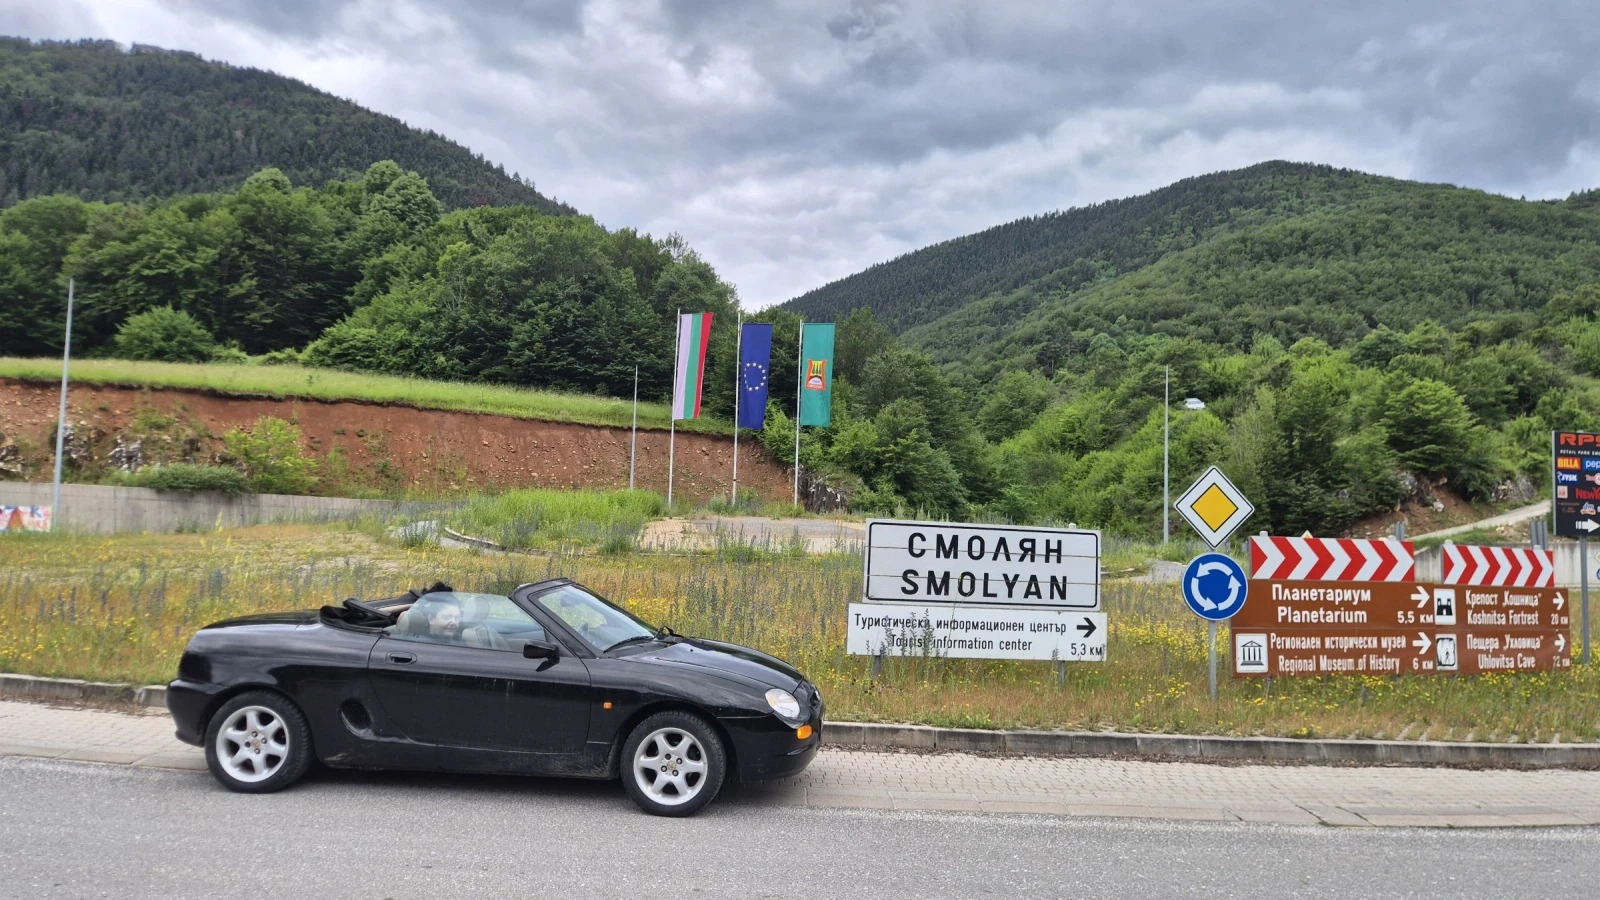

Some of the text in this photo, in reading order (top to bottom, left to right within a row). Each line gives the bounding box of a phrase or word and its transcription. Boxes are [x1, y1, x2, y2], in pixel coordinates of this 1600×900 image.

[1557, 458, 1579, 468] BILLA
[908, 532, 1062, 563] СМОЛЯН
[900, 569, 1067, 600] SMOLYAN
[1272, 584, 1371, 605] Планетариум
[1466, 589, 1498, 609] Крепост
[1278, 606, 1367, 623] Planetarium
[1467, 609, 1539, 625] Koshnitsa Fortrest
[1551, 613, 1559, 625] 20
[936, 619, 1024, 632] информационен
[1030, 622, 1066, 636] център
[934, 636, 993, 650] information
[999, 638, 1032, 651] center
[1070, 643, 1103, 656] 5,3 км
[1271, 633, 1406, 652] Регионален исторически музей
[1467, 634, 1499, 653] Пещера
[1279, 655, 1400, 676] Regional Museum of History
[1412, 657, 1419, 670] 6
[1478, 653, 1535, 669] Uhlovitsa Cave
